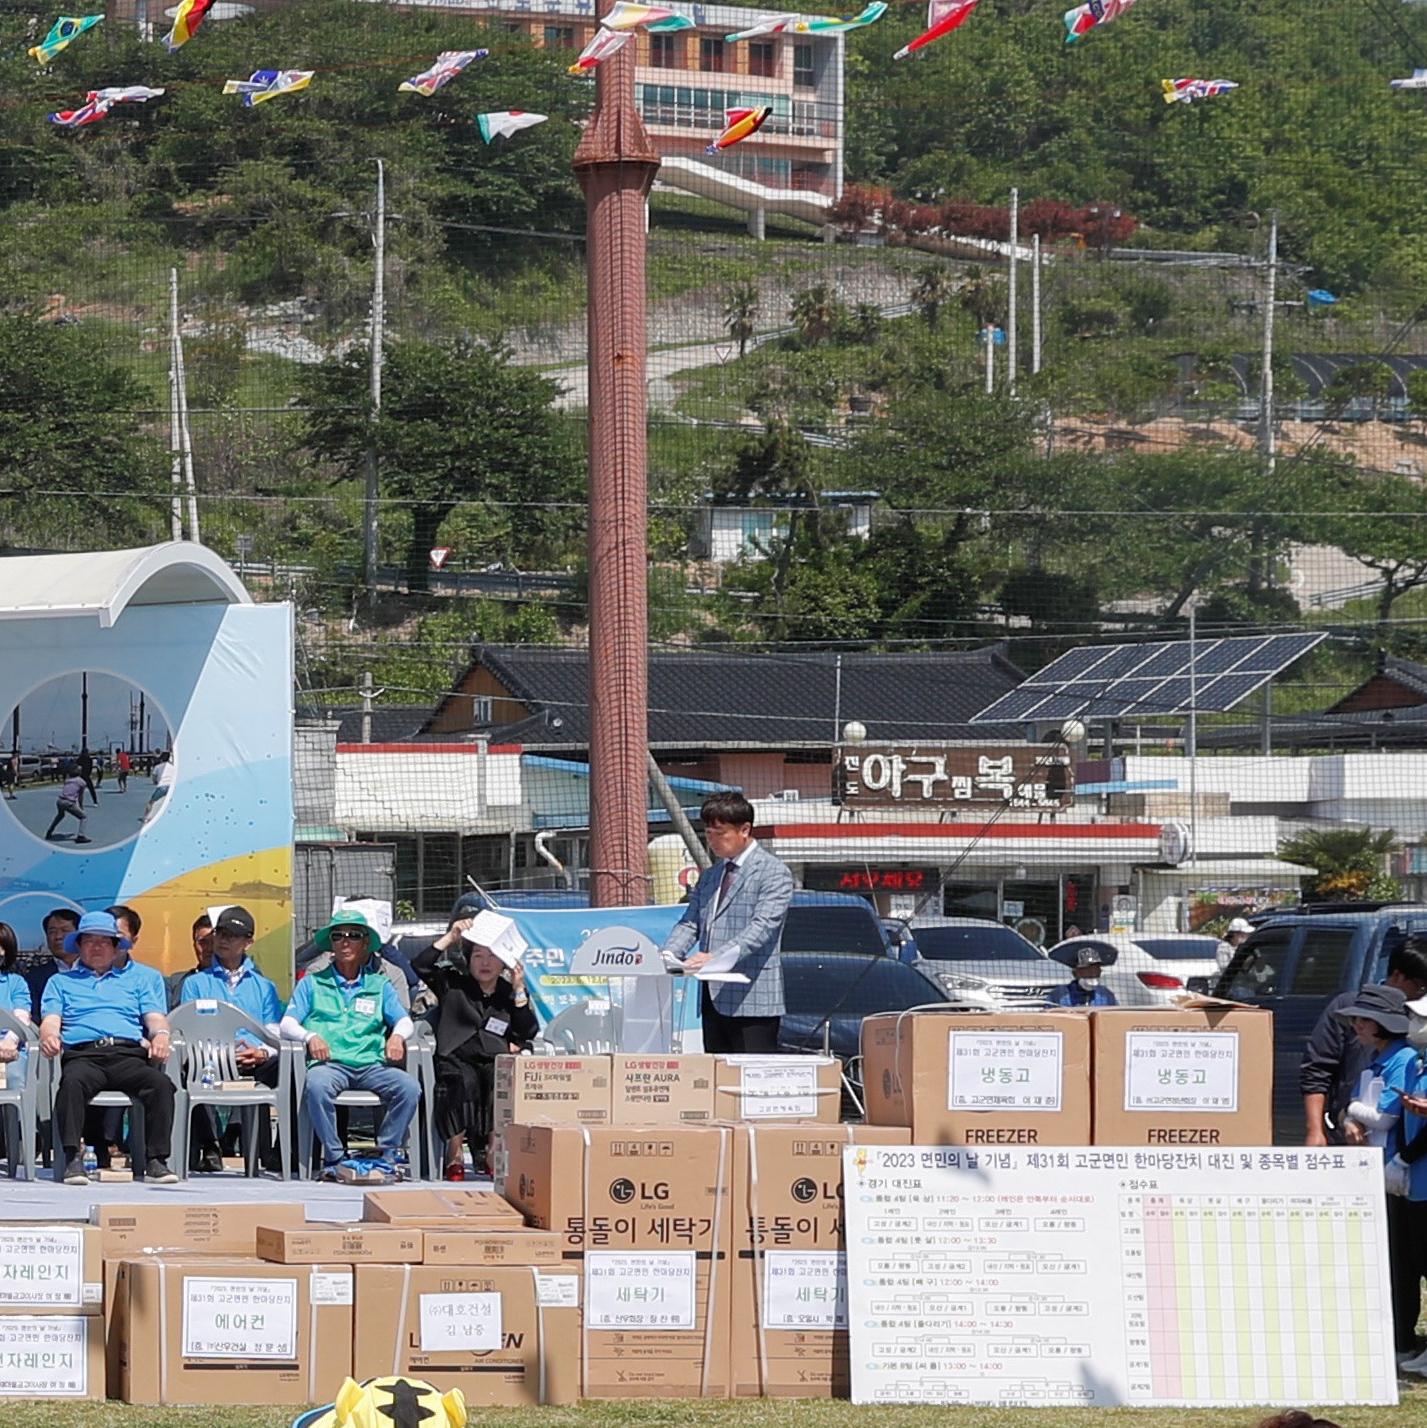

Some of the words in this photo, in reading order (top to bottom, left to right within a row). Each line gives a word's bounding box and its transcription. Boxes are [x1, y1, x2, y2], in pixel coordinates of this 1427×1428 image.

[975, 755, 1016, 798] 복
[525, 948, 566, 968] 주민
[591, 949, 634, 966] Jindo
[524, 1061, 565, 1069] LG생활건강
[625, 1061, 665, 1069] LG생활건강
[653, 1074, 680, 1082] AURA
[981, 1067, 1031, 1084] 냉동고
[1157, 1068, 1207, 1085] 냉동고
[965, 1128, 1038, 1144] FREEZER
[1147, 1129, 1220, 1144] FREEZER
[966, 1153, 979, 1170] 날
[1027, 1153, 1070, 1169] 제31회
[1075, 1152, 1129, 1170] 고군면민
[1134, 1153, 1202, 1170] 한마당잔치
[1208, 1153, 1235, 1170] 대진
[1241, 1153, 1253, 1170] 및
[1258, 1154, 1299, 1170] 종목별
[1305, 1153, 1346, 1170] 점수표
[640, 1182, 669, 1200] LG
[1129, 1179, 1158, 1190] 점수표
[563, 1216, 636, 1245] 통돌이
[745, 1216, 818, 1245] 통돌이
[615, 1286, 665, 1303] 세탁기
[215, 1313, 265, 1330] 에어컨
